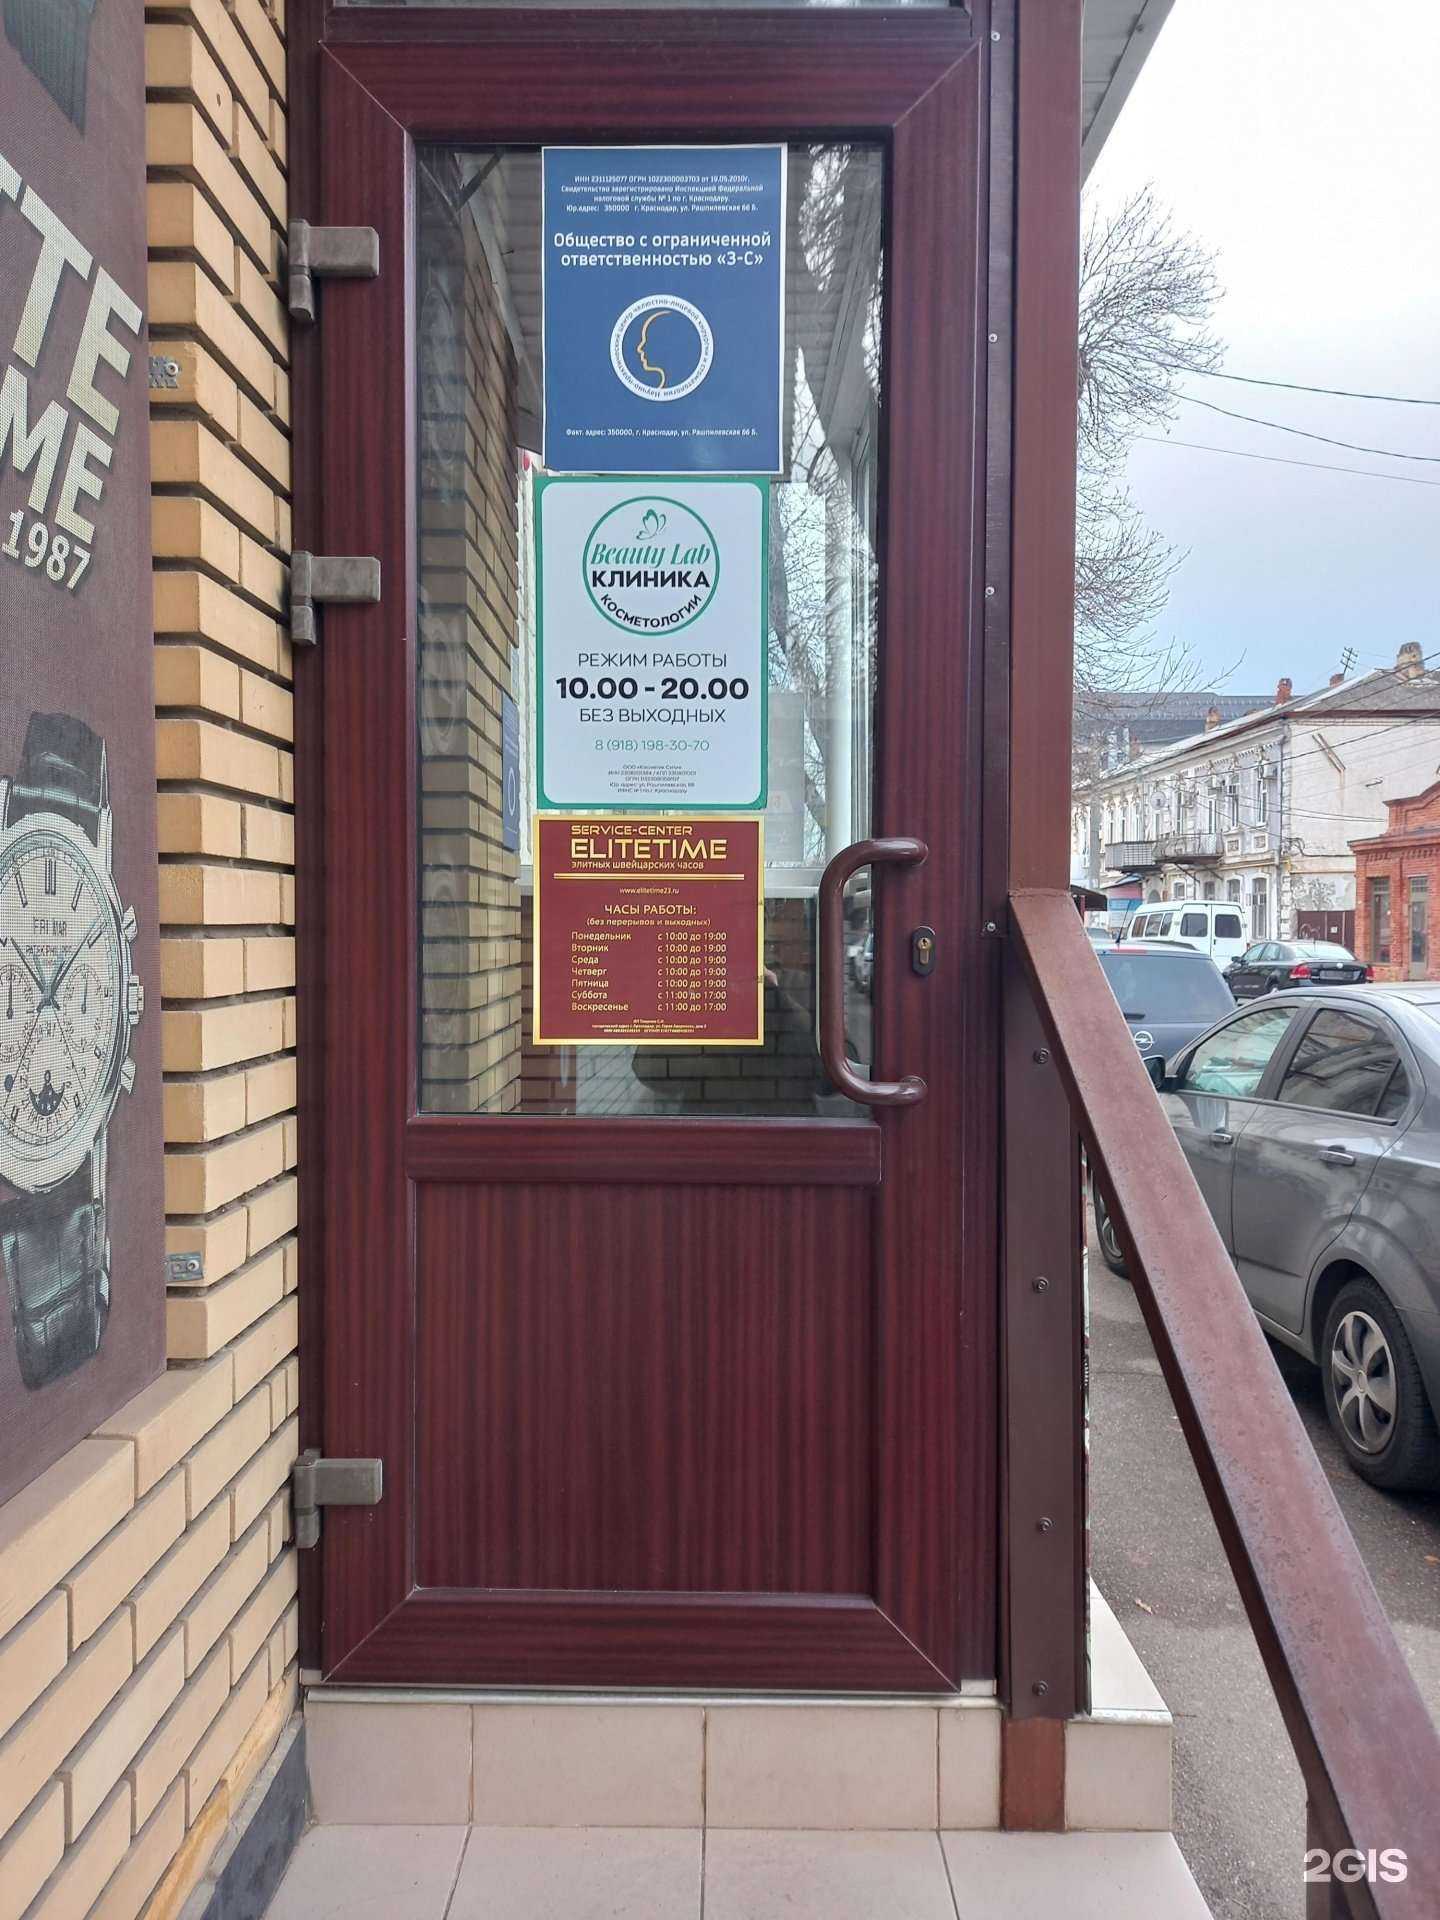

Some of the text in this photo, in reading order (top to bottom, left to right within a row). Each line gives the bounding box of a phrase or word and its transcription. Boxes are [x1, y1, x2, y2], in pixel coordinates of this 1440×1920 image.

[574, 175, 590, 183] ИНН
[629, 175, 647, 183] ОГРН
[561, 183, 764, 195] Свидетельство зарегистрировано Инспекцией Федеральной
[593, 194, 629, 203] налоговой
[630, 194, 657, 204] службы
[672, 195, 681, 203] по
[604, 204, 630, 212] 350000
[691, 203, 740, 213] Рашпилевская
[553, 231, 771, 250] Общество с ограниченной
[561, 252, 712, 267] ответственностью
[0, 153, 142, 436] TE
[2, 509, 91, 590] 1987
[590, 543, 711, 569] Beauty Lab
[592, 570, 710, 588] КЛИНИКА
[600, 593, 702, 629] КОСМЕТОЛОГИИ
[578, 653, 728, 668] РЕЖИМ РАБОТЫ
[556, 677, 639, 700] 10.00
[661, 677, 750, 700] 20.00
[579, 708, 727, 725] БЕЗ ВЫХОДНЫХ
[595, 739, 710, 752] 8 (918) 198-30-70
[571, 825, 693, 836] SERVICE-CENTER
[570, 838, 727, 860] ELITETIME
[571, 859, 704, 871] элитных швейцарских часов
[619, 887, 680, 895] www.elitetime23.ru
[604, 904, 697, 915] ЧАСЫ РАБОТЫ:
[586, 918, 605, 927] (без
[606, 919, 656, 927] перерывов
[664, 918, 711, 927] выходных)
[571, 931, 632, 942] Понедельник
[665, 932, 688, 941] 10:00
[689, 933, 701, 942] до
[703, 932, 727, 941] 19:00
[571, 944, 609, 953] Вторник
[665, 944, 688, 953] 10:00
[689, 945, 701, 954] до
[703, 944, 727, 953] 19:00
[571, 955, 727, 966] Среда с 10:00 до 19:00
[571, 967, 608, 976] Четверг
[665, 967, 688, 976] 10:00
[689, 969, 701, 978] до
[703, 967, 727, 976] 19:00
[571, 979, 609, 988] Пятница
[665, 979, 688, 988] 10:00
[689, 981, 701, 989] до
[703, 979, 727, 988] 19:00
[571, 990, 608, 1000] Суббота
[665, 991, 688, 1000] 11:00
[689, 992, 701, 1001] до
[703, 991, 727, 1000] 17:00
[571, 1002, 727, 1013] Воскресенье с 11:00 до 17:00
